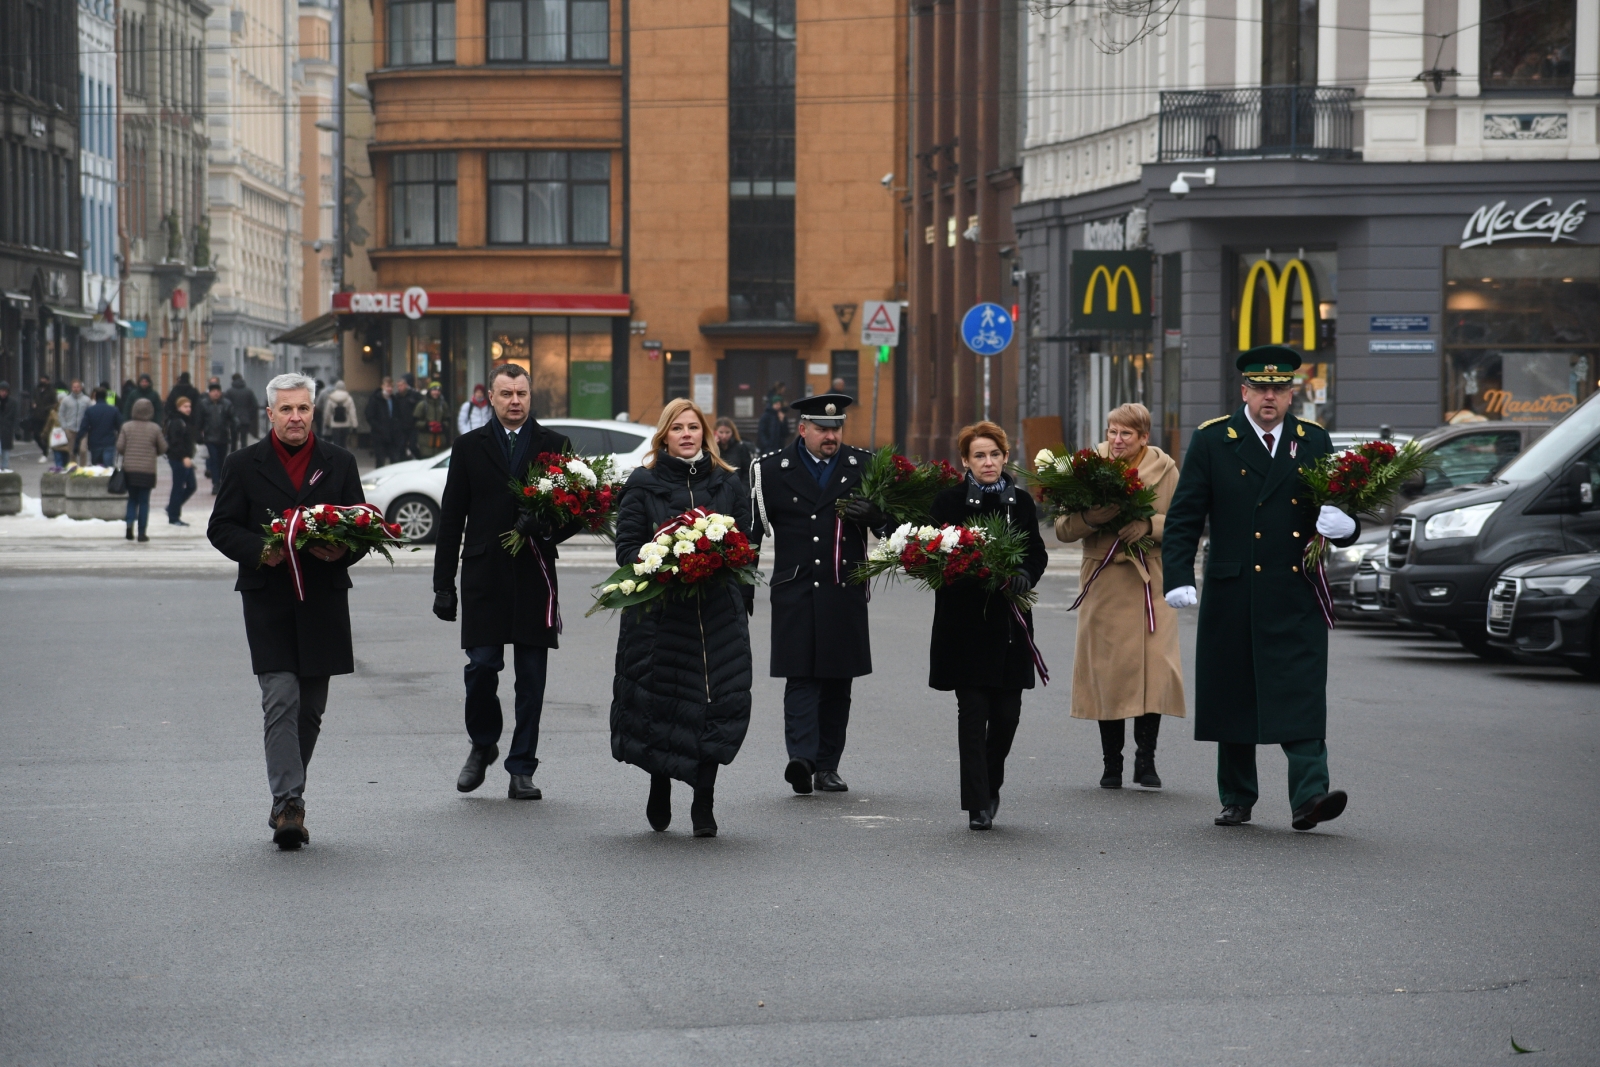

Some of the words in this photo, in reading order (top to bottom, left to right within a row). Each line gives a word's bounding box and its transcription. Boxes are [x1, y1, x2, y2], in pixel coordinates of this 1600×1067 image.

[1461, 197, 1587, 247] McCafé
[350, 293, 401, 313] CIRCLE
[408, 294, 425, 316] K
[1483, 389, 1577, 417] Maestro
